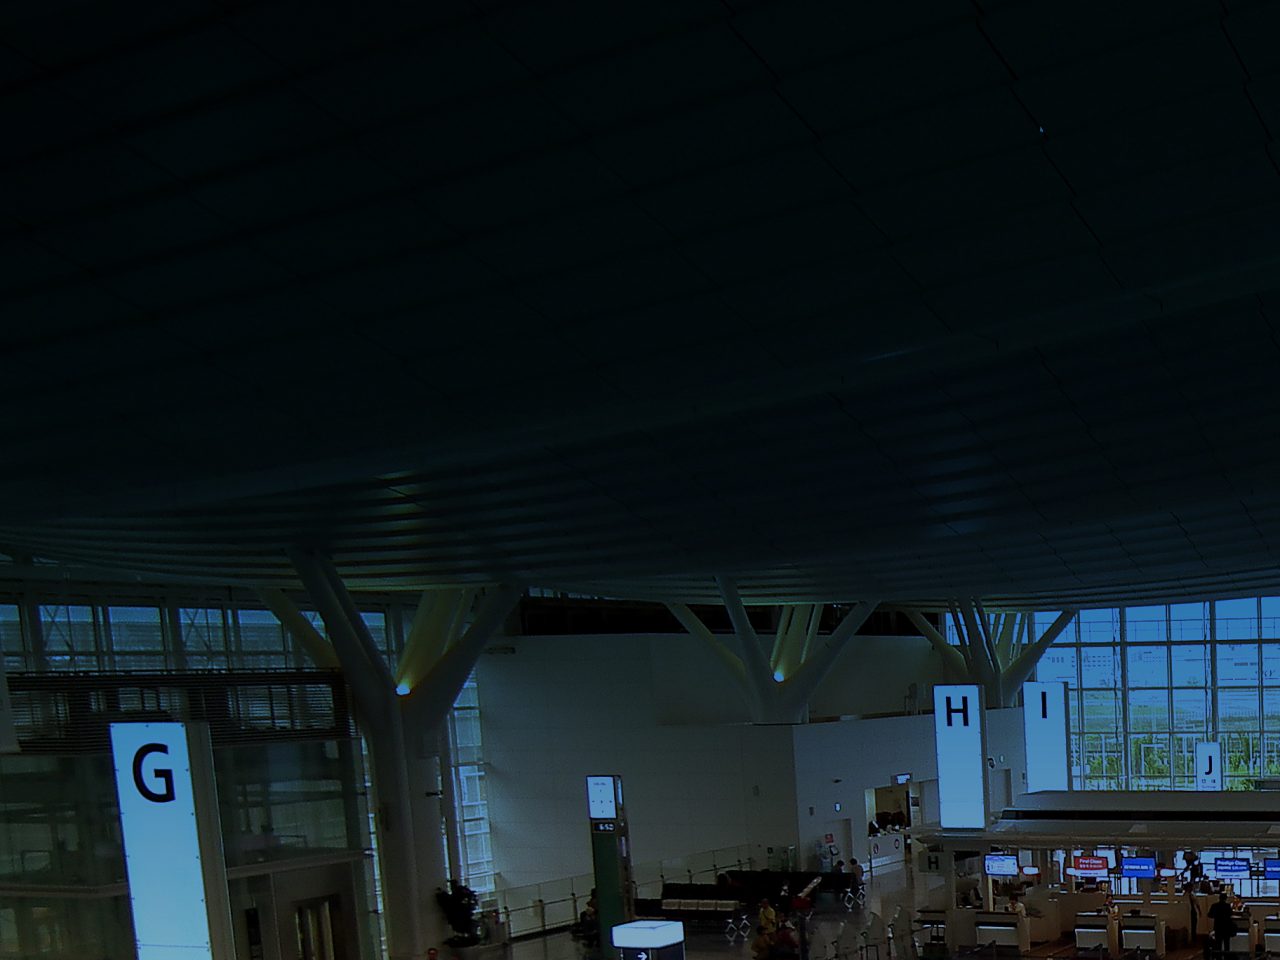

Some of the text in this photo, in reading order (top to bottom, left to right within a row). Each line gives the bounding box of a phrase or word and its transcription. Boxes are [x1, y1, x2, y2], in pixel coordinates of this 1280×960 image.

[945, 696, 969, 727] H
[1041, 691, 1047, 720] I
[132, 742, 176, 803] G
[1204, 755, 1213, 775] J
[927, 855, 939, 870] H
